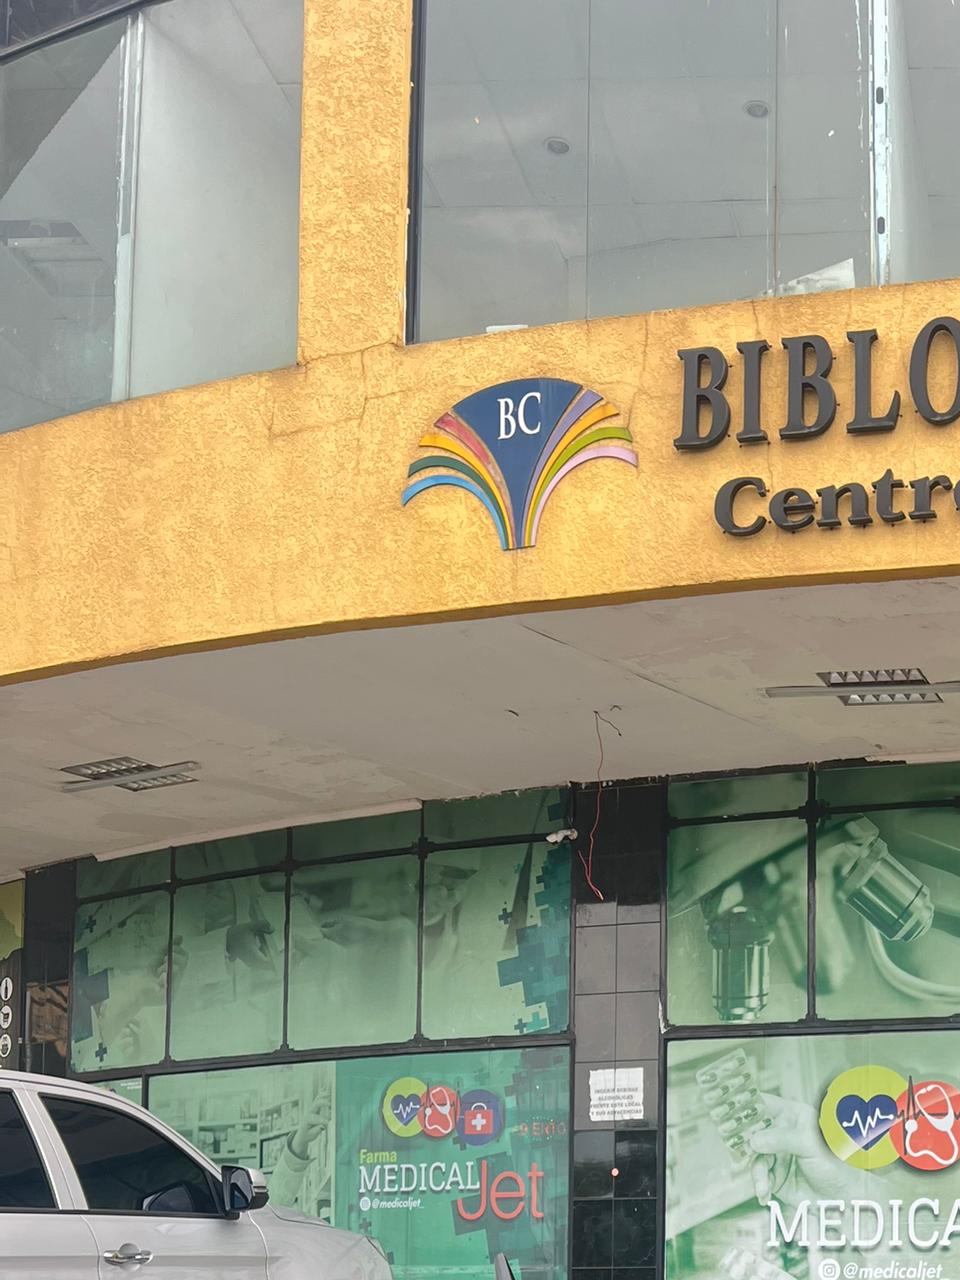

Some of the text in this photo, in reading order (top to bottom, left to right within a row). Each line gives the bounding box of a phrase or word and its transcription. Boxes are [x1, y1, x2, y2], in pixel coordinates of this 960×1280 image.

[498, 391, 542, 440] BC
[359, 1149, 398, 1164] Farma
[358, 1159, 545, 1220] MEDICAL Jet
